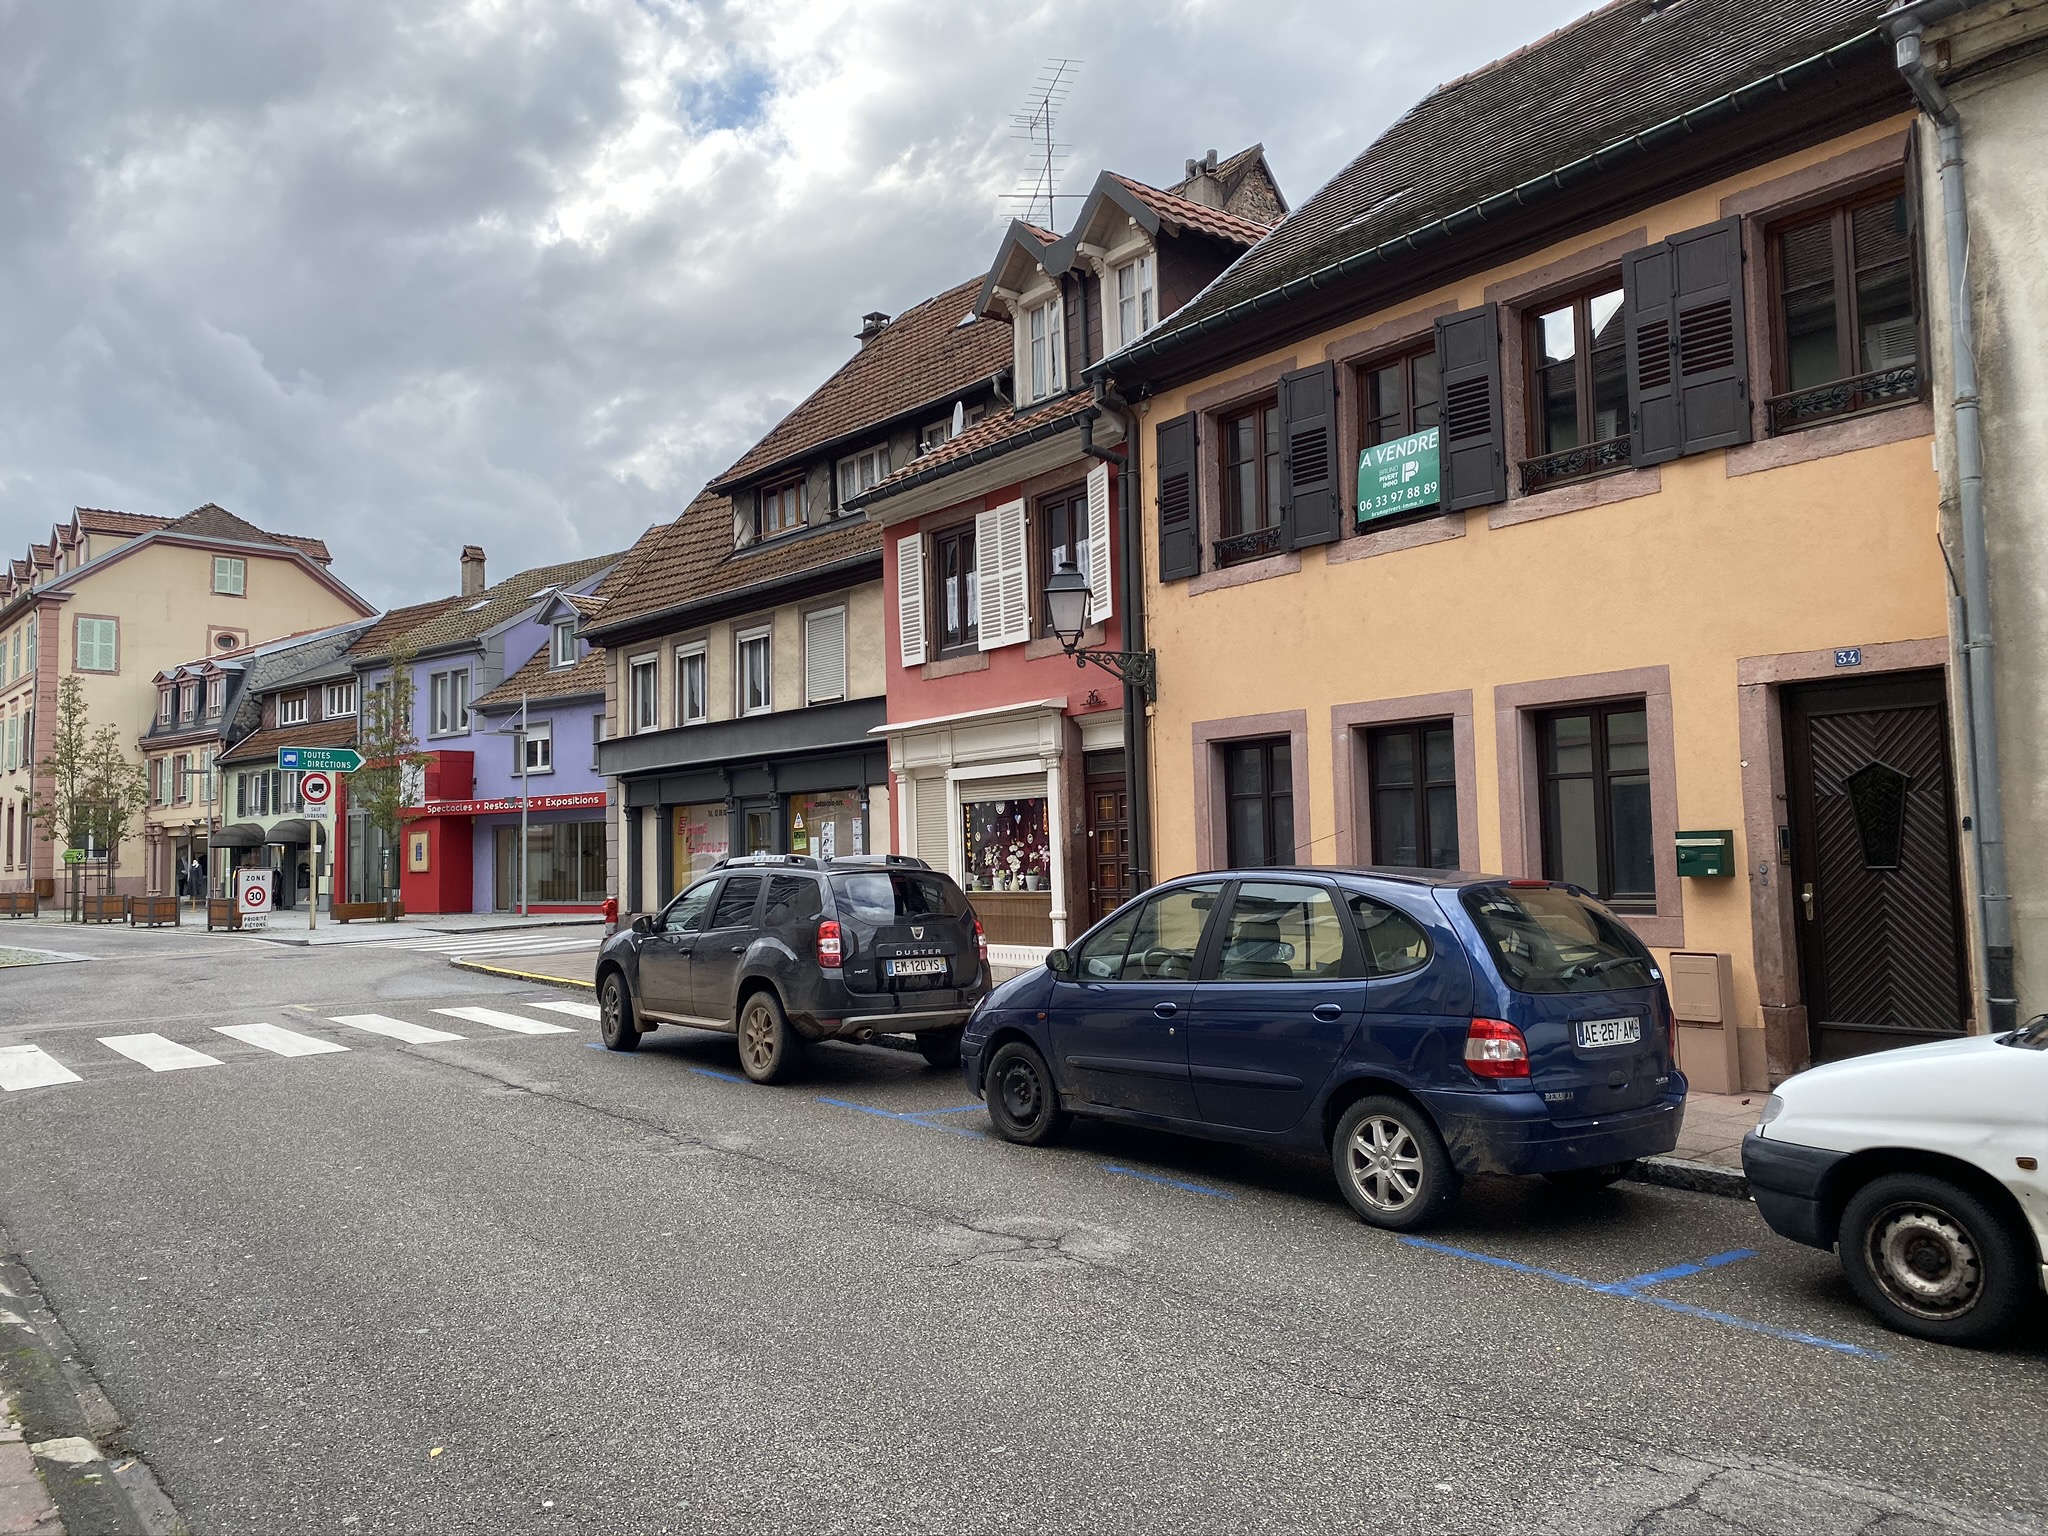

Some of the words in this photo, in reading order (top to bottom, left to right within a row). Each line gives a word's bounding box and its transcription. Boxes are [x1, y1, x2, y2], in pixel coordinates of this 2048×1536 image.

[1360, 452, 1372, 470] A
[1376, 432, 1439, 464] VENDRE
[1379, 465, 1399, 477] BRUNO
[1379, 472, 1399, 483] PIVERT
[1382, 479, 1398, 489] IMMO
[1359, 499, 1373, 512] 06
[1375, 495, 1388, 508] 33
[1390, 490, 1404, 504] 97
[1407, 486, 1421, 499] 88
[1423, 481, 1438, 495] 89
[1838, 651, 1857, 664] 34
[303, 751, 331, 760] TOUTES
[427, 803, 473, 814] Spectacles
[484, 799, 534, 811] Restaurat
[545, 796, 600, 807] Expositions
[249, 891, 262, 901] 30
[894, 959, 940, 973] EM-120-YS
